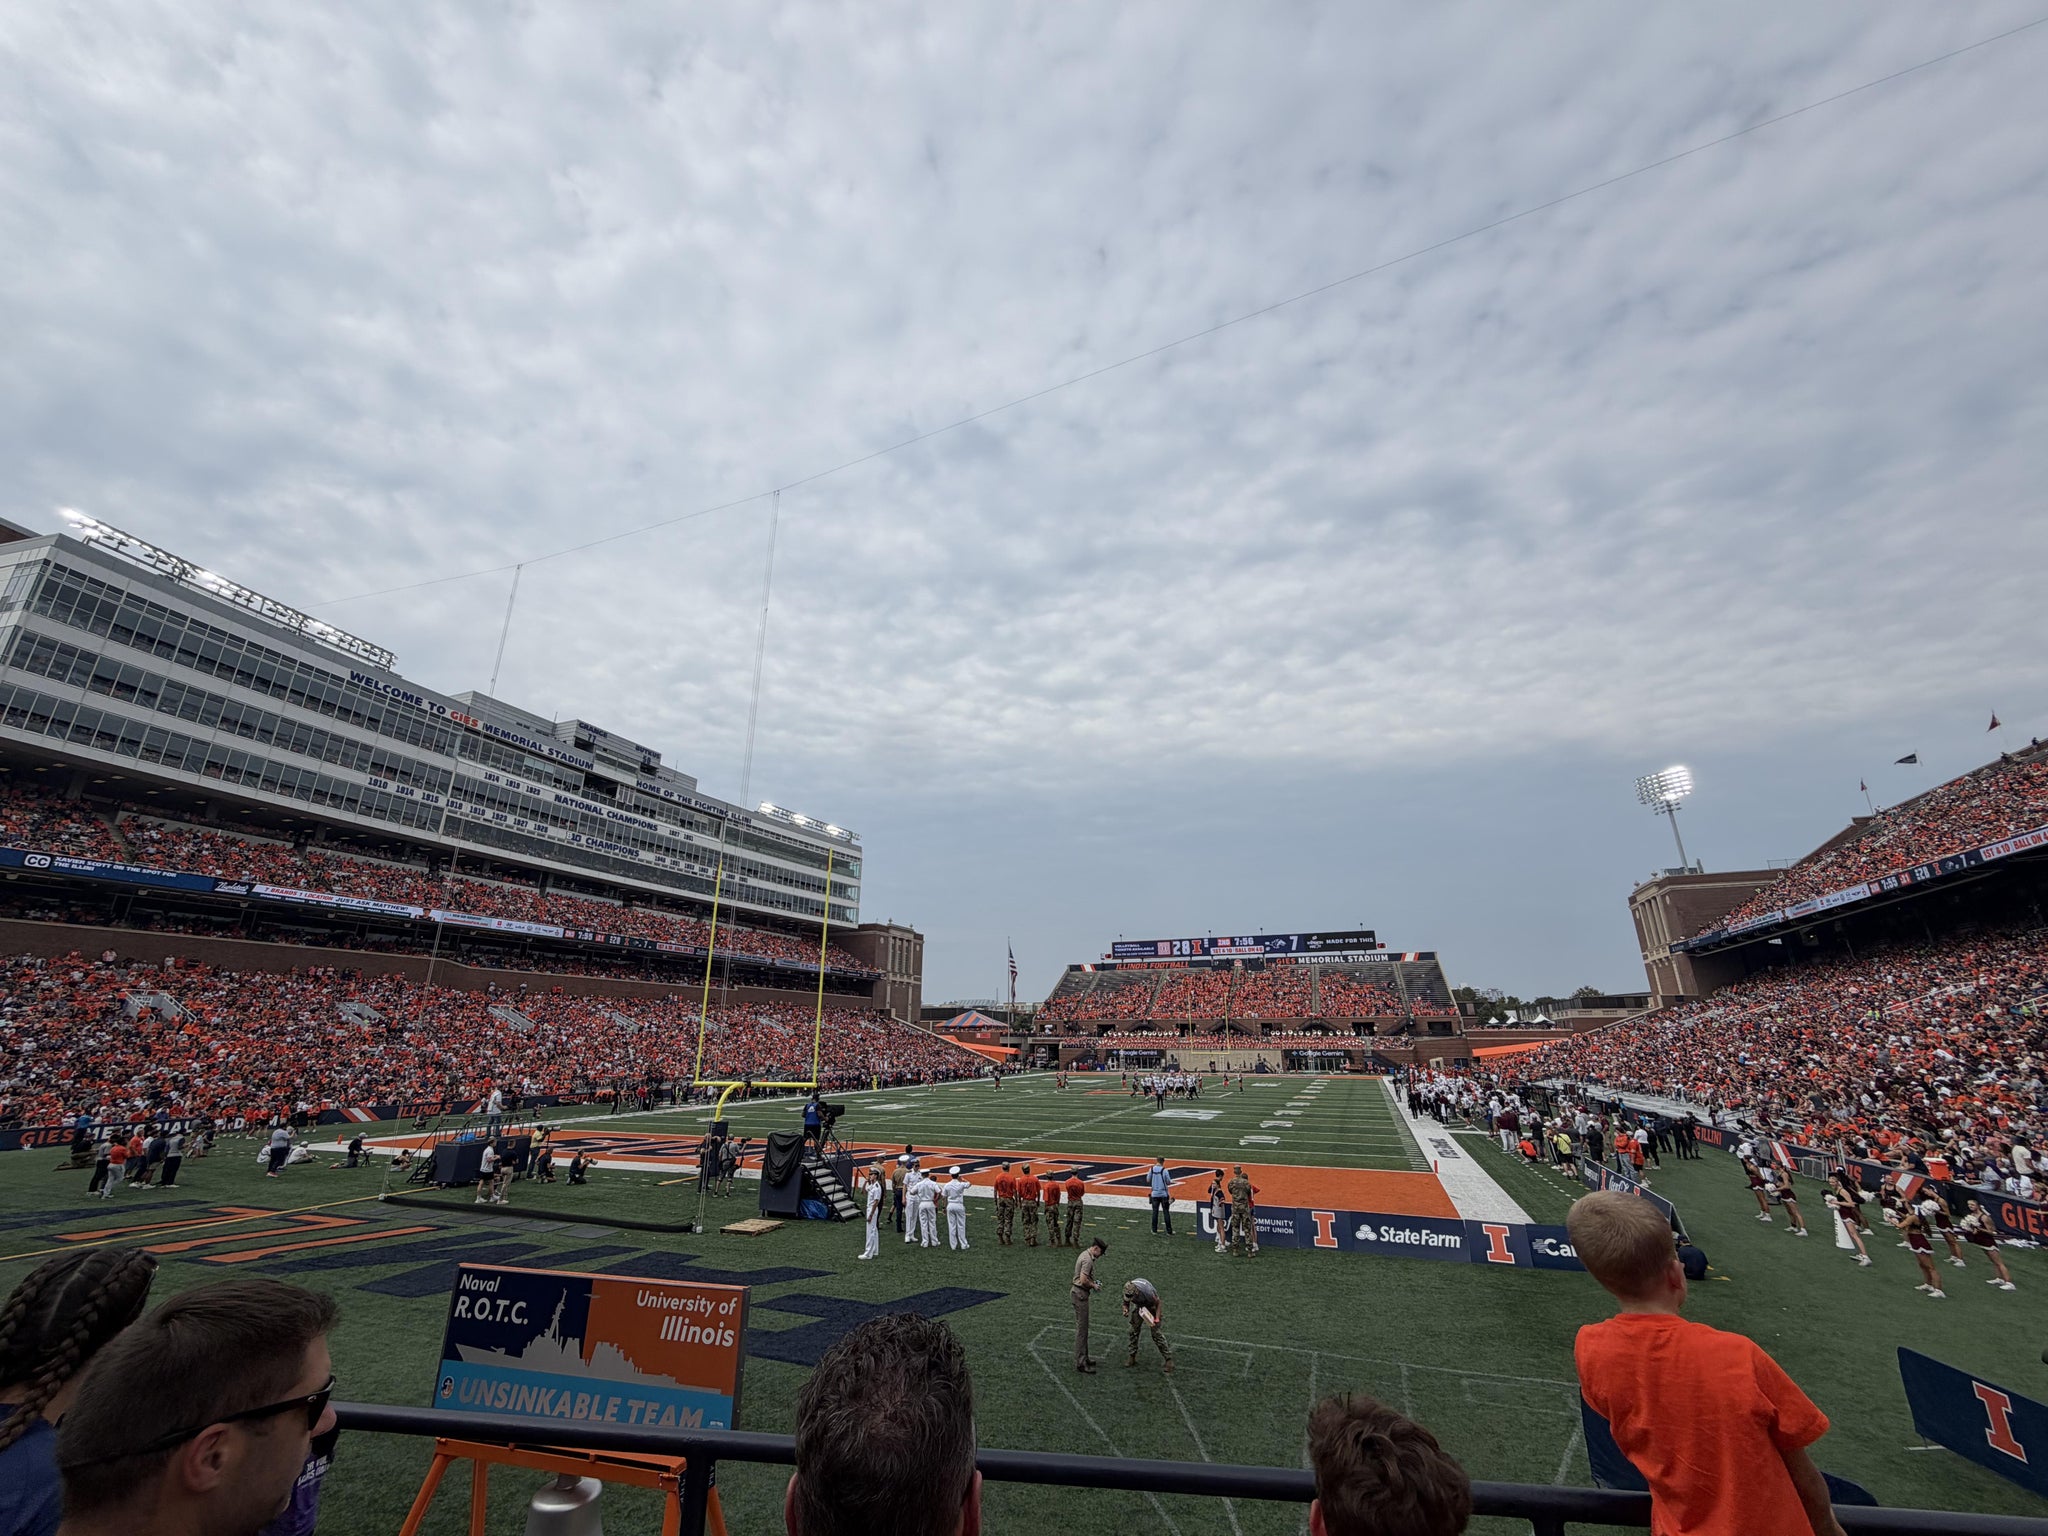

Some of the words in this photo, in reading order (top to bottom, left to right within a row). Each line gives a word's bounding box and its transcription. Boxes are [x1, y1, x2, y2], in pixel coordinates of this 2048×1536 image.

[350, 670, 423, 706] WELCOME
[428, 700, 446, 714] TO
[450, 710, 478, 728] GIES
[483, 722, 544, 751] MEMORIAL
[548, 748, 594, 770] STADIUM
[579, 722, 608, 738] GRANGE
[588, 734, 596, 744] 77
[635, 744, 661, 759] BUTKUS
[484, 772, 500, 783] 1914
[506, 779, 520, 789] 1919
[526, 785, 541, 795] 1923
[554, 794, 604, 816] NATIONAL
[607, 811, 658, 831] CHAMPIONS
[636, 780, 661, 793] HOME
[664, 790, 674, 798] OF
[677, 794, 692, 804] THE
[695, 800, 729, 818] FIGHTING
[731, 812, 752, 824] ILLINI
[368, 777, 388, 789] 1910
[396, 785, 414, 797] 1914
[421, 792, 440, 803] 1915
[492, 812, 508, 822] 1923
[513, 818, 528, 827] 1927
[586, 837, 640, 857] CHAMPIONS
[26, 856, 49, 867] CC
[87, 860, 112, 868] SCOTT
[1881, 876, 1898, 890] 7:55
[1920, 867, 1930, 880] 28
[1933, 863, 1942, 876] I
[1960, 854, 1967, 868] 7
[1983, 848, 1995, 859] 1ST
[2002, 843, 2010, 854] 10
[2013, 839, 2031, 850] BALL
[2031, 836, 2043, 845] ON
[270, 888, 297, 896] BRANDS
[372, 903, 408, 911] MATTHEW!
[1173, 940, 1190, 955] 28
[1192, 940, 1202, 954] I
[1290, 936, 1298, 951] 7
[1150, 961, 1189, 969] FOOTBALL
[1298, 956, 1345, 964] MEMORIAL
[1348, 954, 1388, 962] STADIUM
[400, 1103, 452, 1118] ILLINOS
[20, 1129, 75, 1145] GIES
[86, 1121, 194, 1140] MERIAL
[1701, 1127, 1722, 1145] ILLINI
[1253, 1218, 1294, 1227] OMMUNITY
[1312, 1211, 1338, 1248] I
[2002, 1202, 2048, 1237] GIE
[1482, 1224, 1515, 1264] I
[459, 1273, 501, 1292] Naval
[454, 1296, 528, 1325] R.O.T.C.
[637, 1290, 715, 1317] University
[718, 1298, 738, 1315] of
[660, 1316, 735, 1348] Illinois
[459, 1377, 622, 1422] UNSINKABLE
[627, 1399, 704, 1429] TEAM
[1972, 1380, 2028, 1464] I
